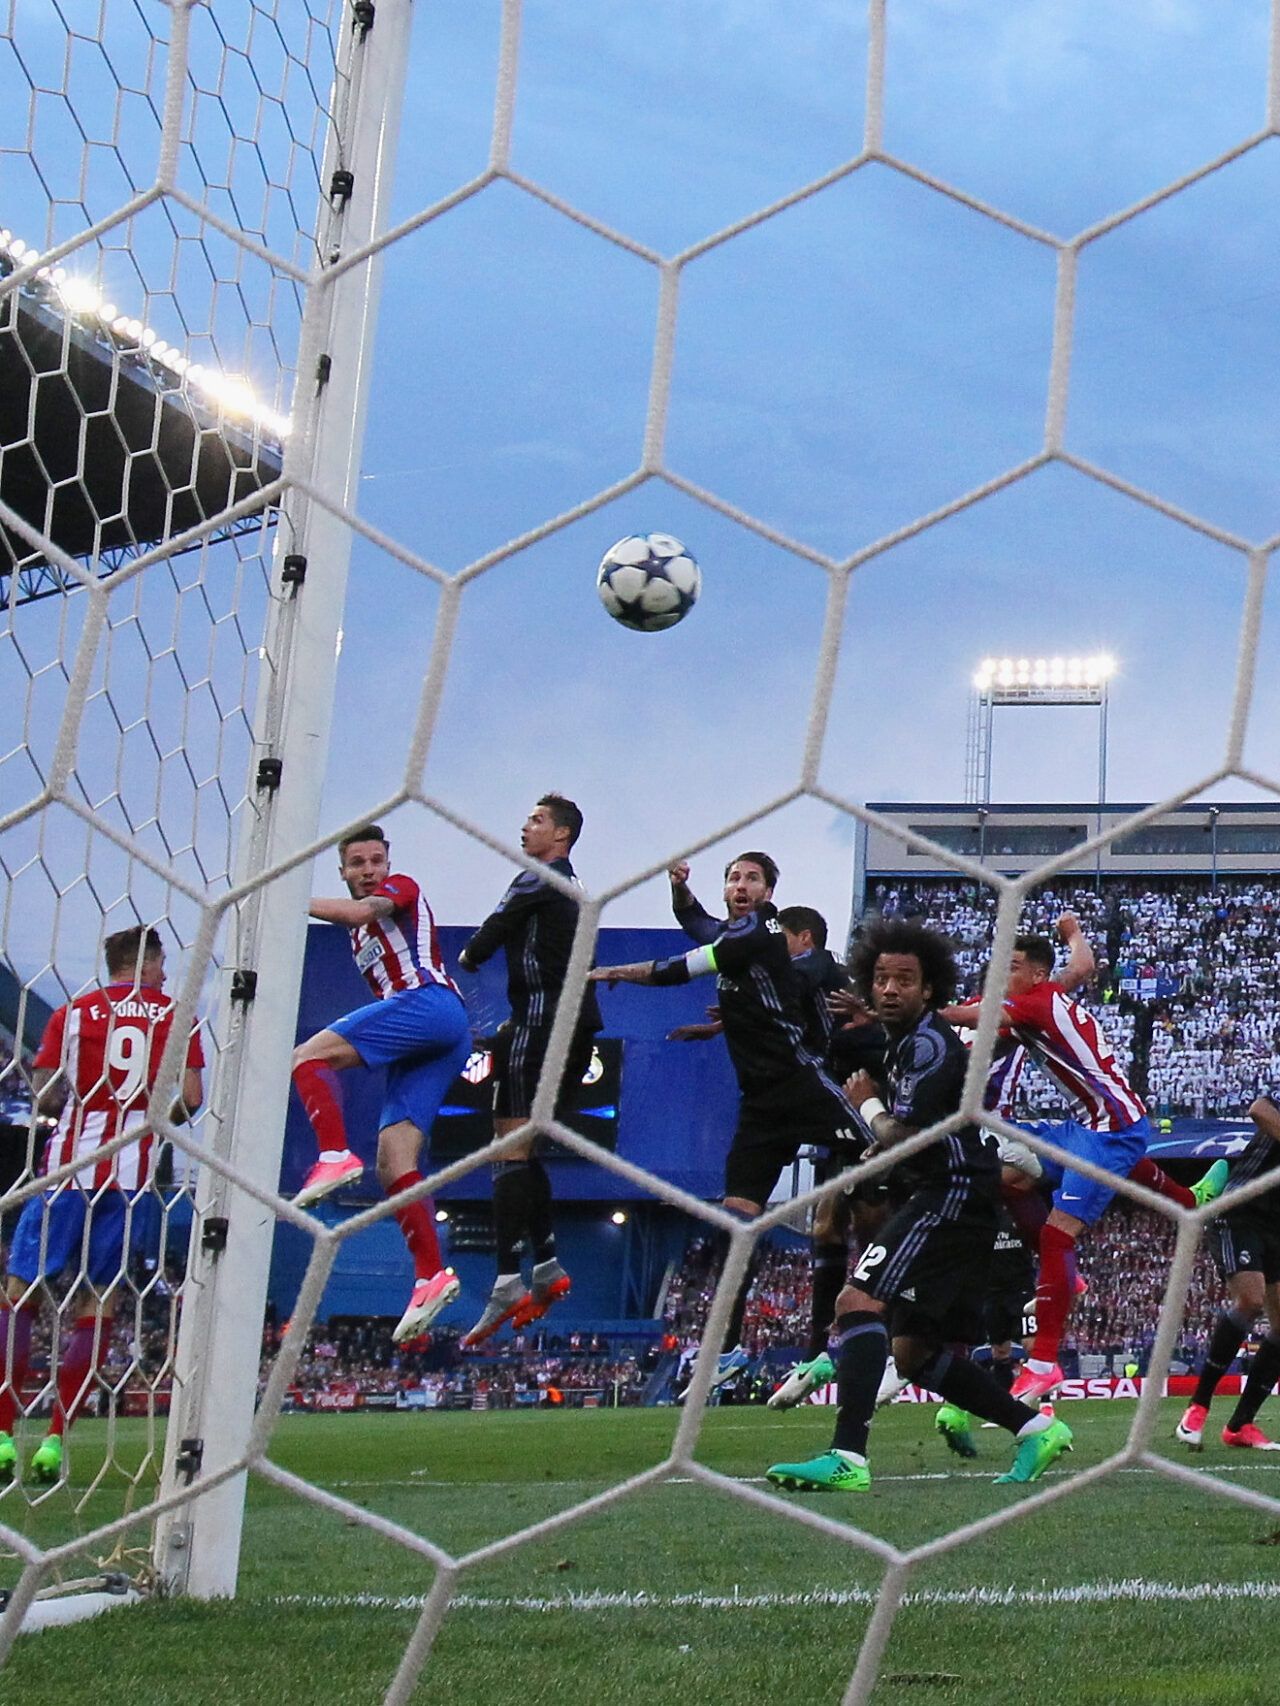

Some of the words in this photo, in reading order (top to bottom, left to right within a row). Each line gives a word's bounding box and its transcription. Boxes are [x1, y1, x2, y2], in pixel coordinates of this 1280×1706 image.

[90, 1004, 107, 1020] F.
[109, 1025, 147, 1100] 9
[853, 1243, 887, 1282] 12
[1021, 1315, 1038, 1336] 19
